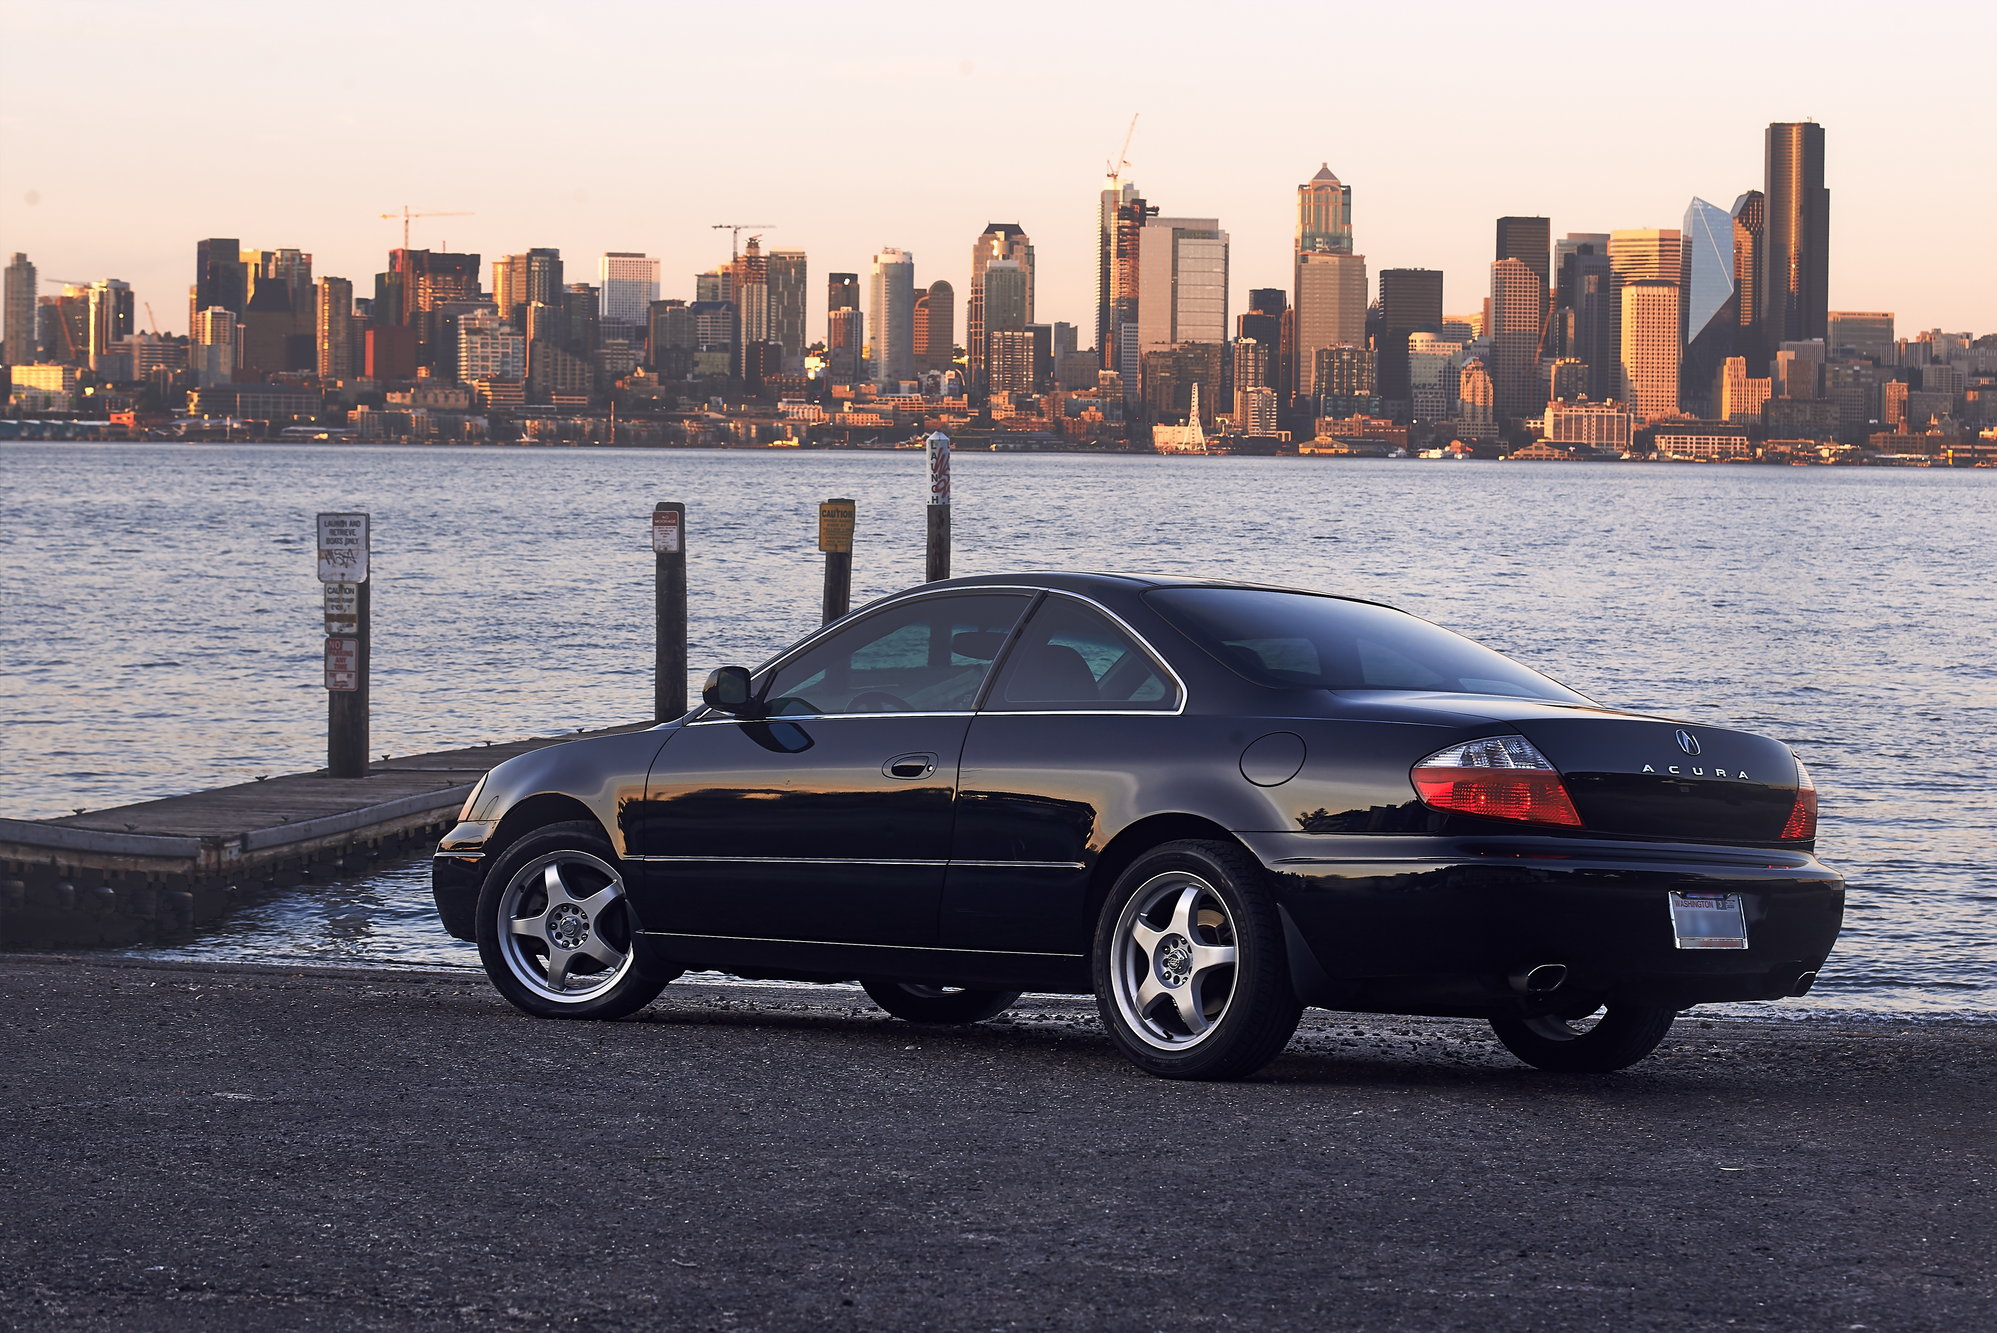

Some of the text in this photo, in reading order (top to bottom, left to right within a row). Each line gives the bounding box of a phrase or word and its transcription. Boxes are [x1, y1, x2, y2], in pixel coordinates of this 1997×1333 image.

[822, 510, 852, 518] CAUTION
[324, 519, 361, 528] LAUNCH AND
[328, 528, 356, 536] RETRIEVE
[325, 536, 359, 545] BOATS ONLY
[329, 640, 341, 649] NO
[1641, 764, 1749, 779] ACURA
[1674, 899, 1714, 909] WASHINGTON
